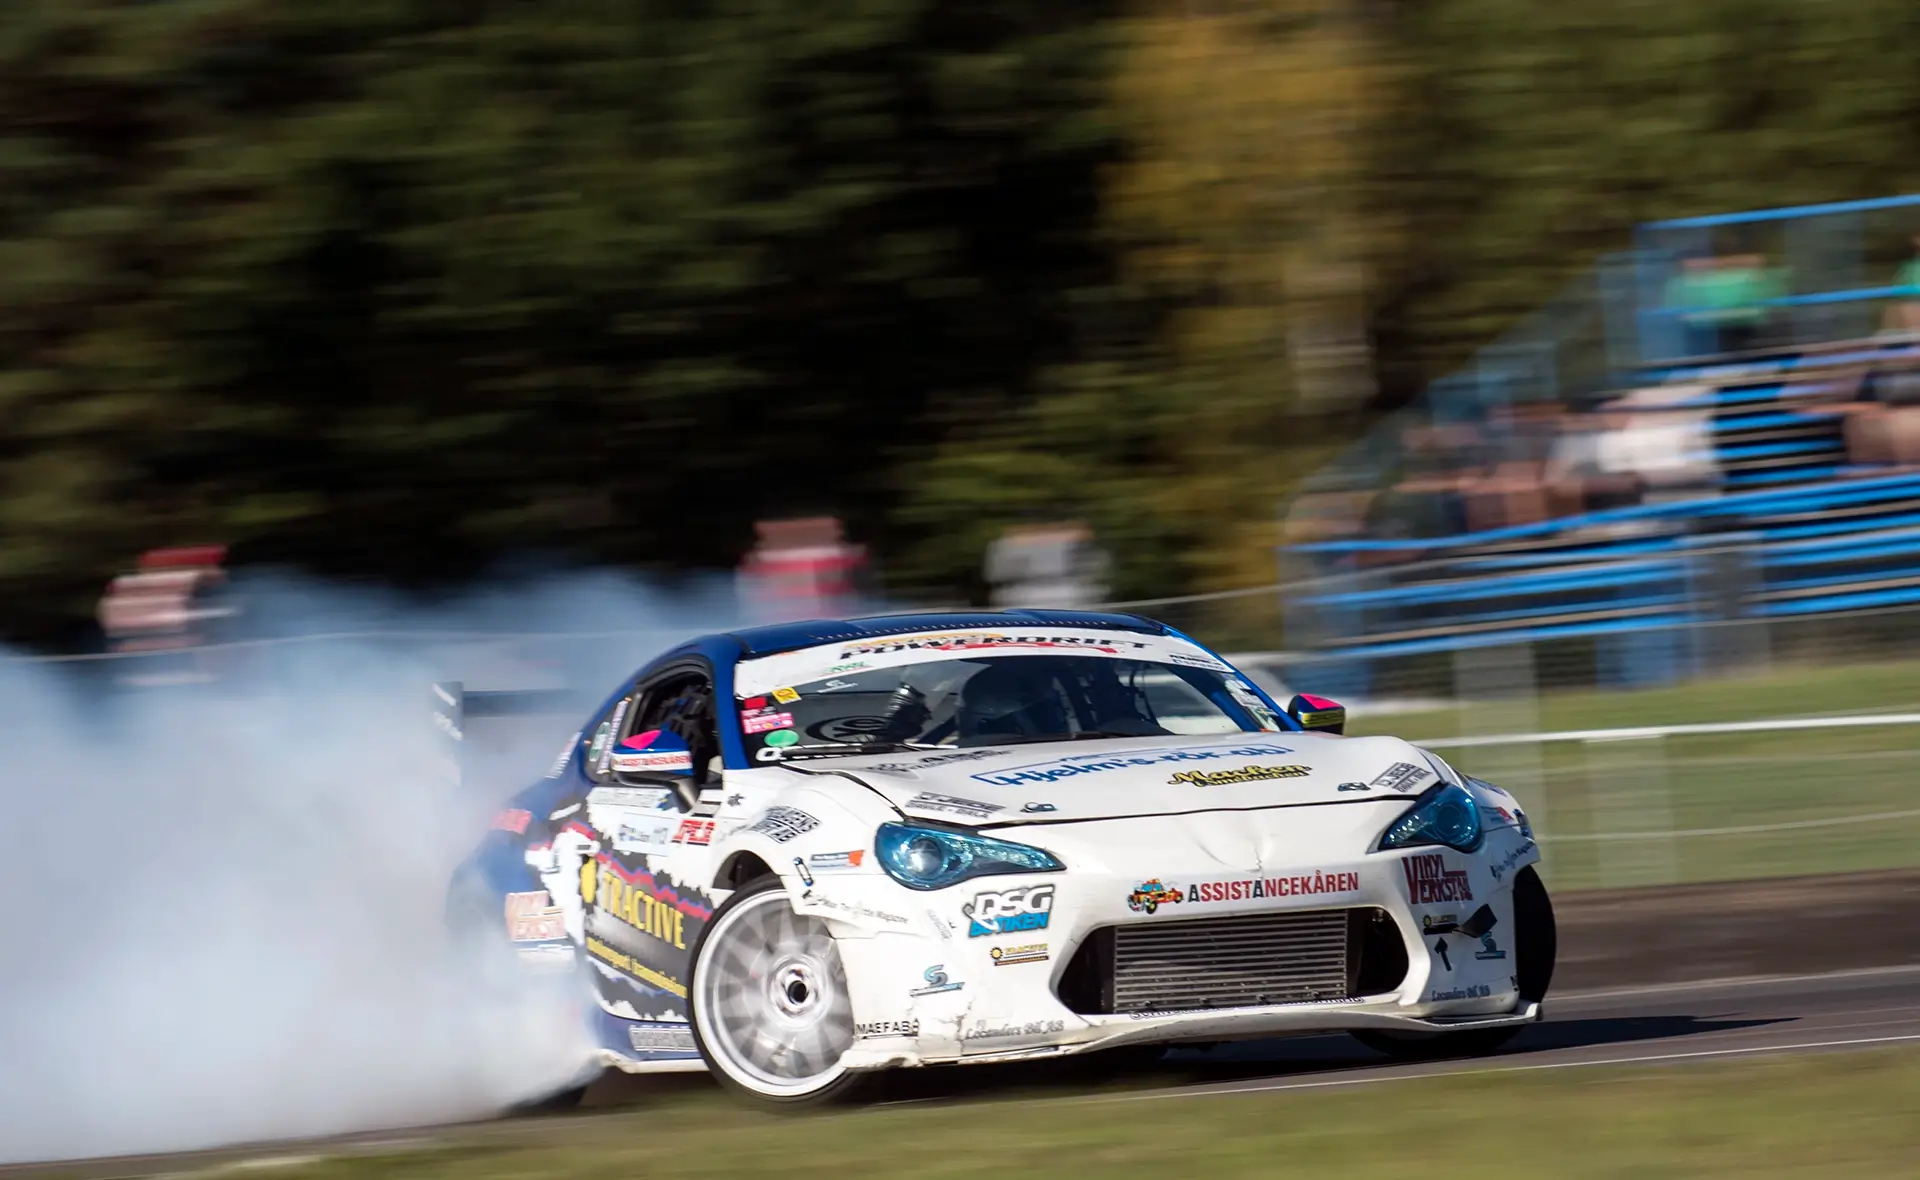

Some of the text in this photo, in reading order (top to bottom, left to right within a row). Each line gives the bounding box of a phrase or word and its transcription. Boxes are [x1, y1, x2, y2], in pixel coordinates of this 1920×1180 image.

[839, 634, 1153, 660] POWERDRIFT
[1187, 869, 1358, 903] ASSISTANCEKÅREN
[603, 870, 686, 950] TRACTIVE
